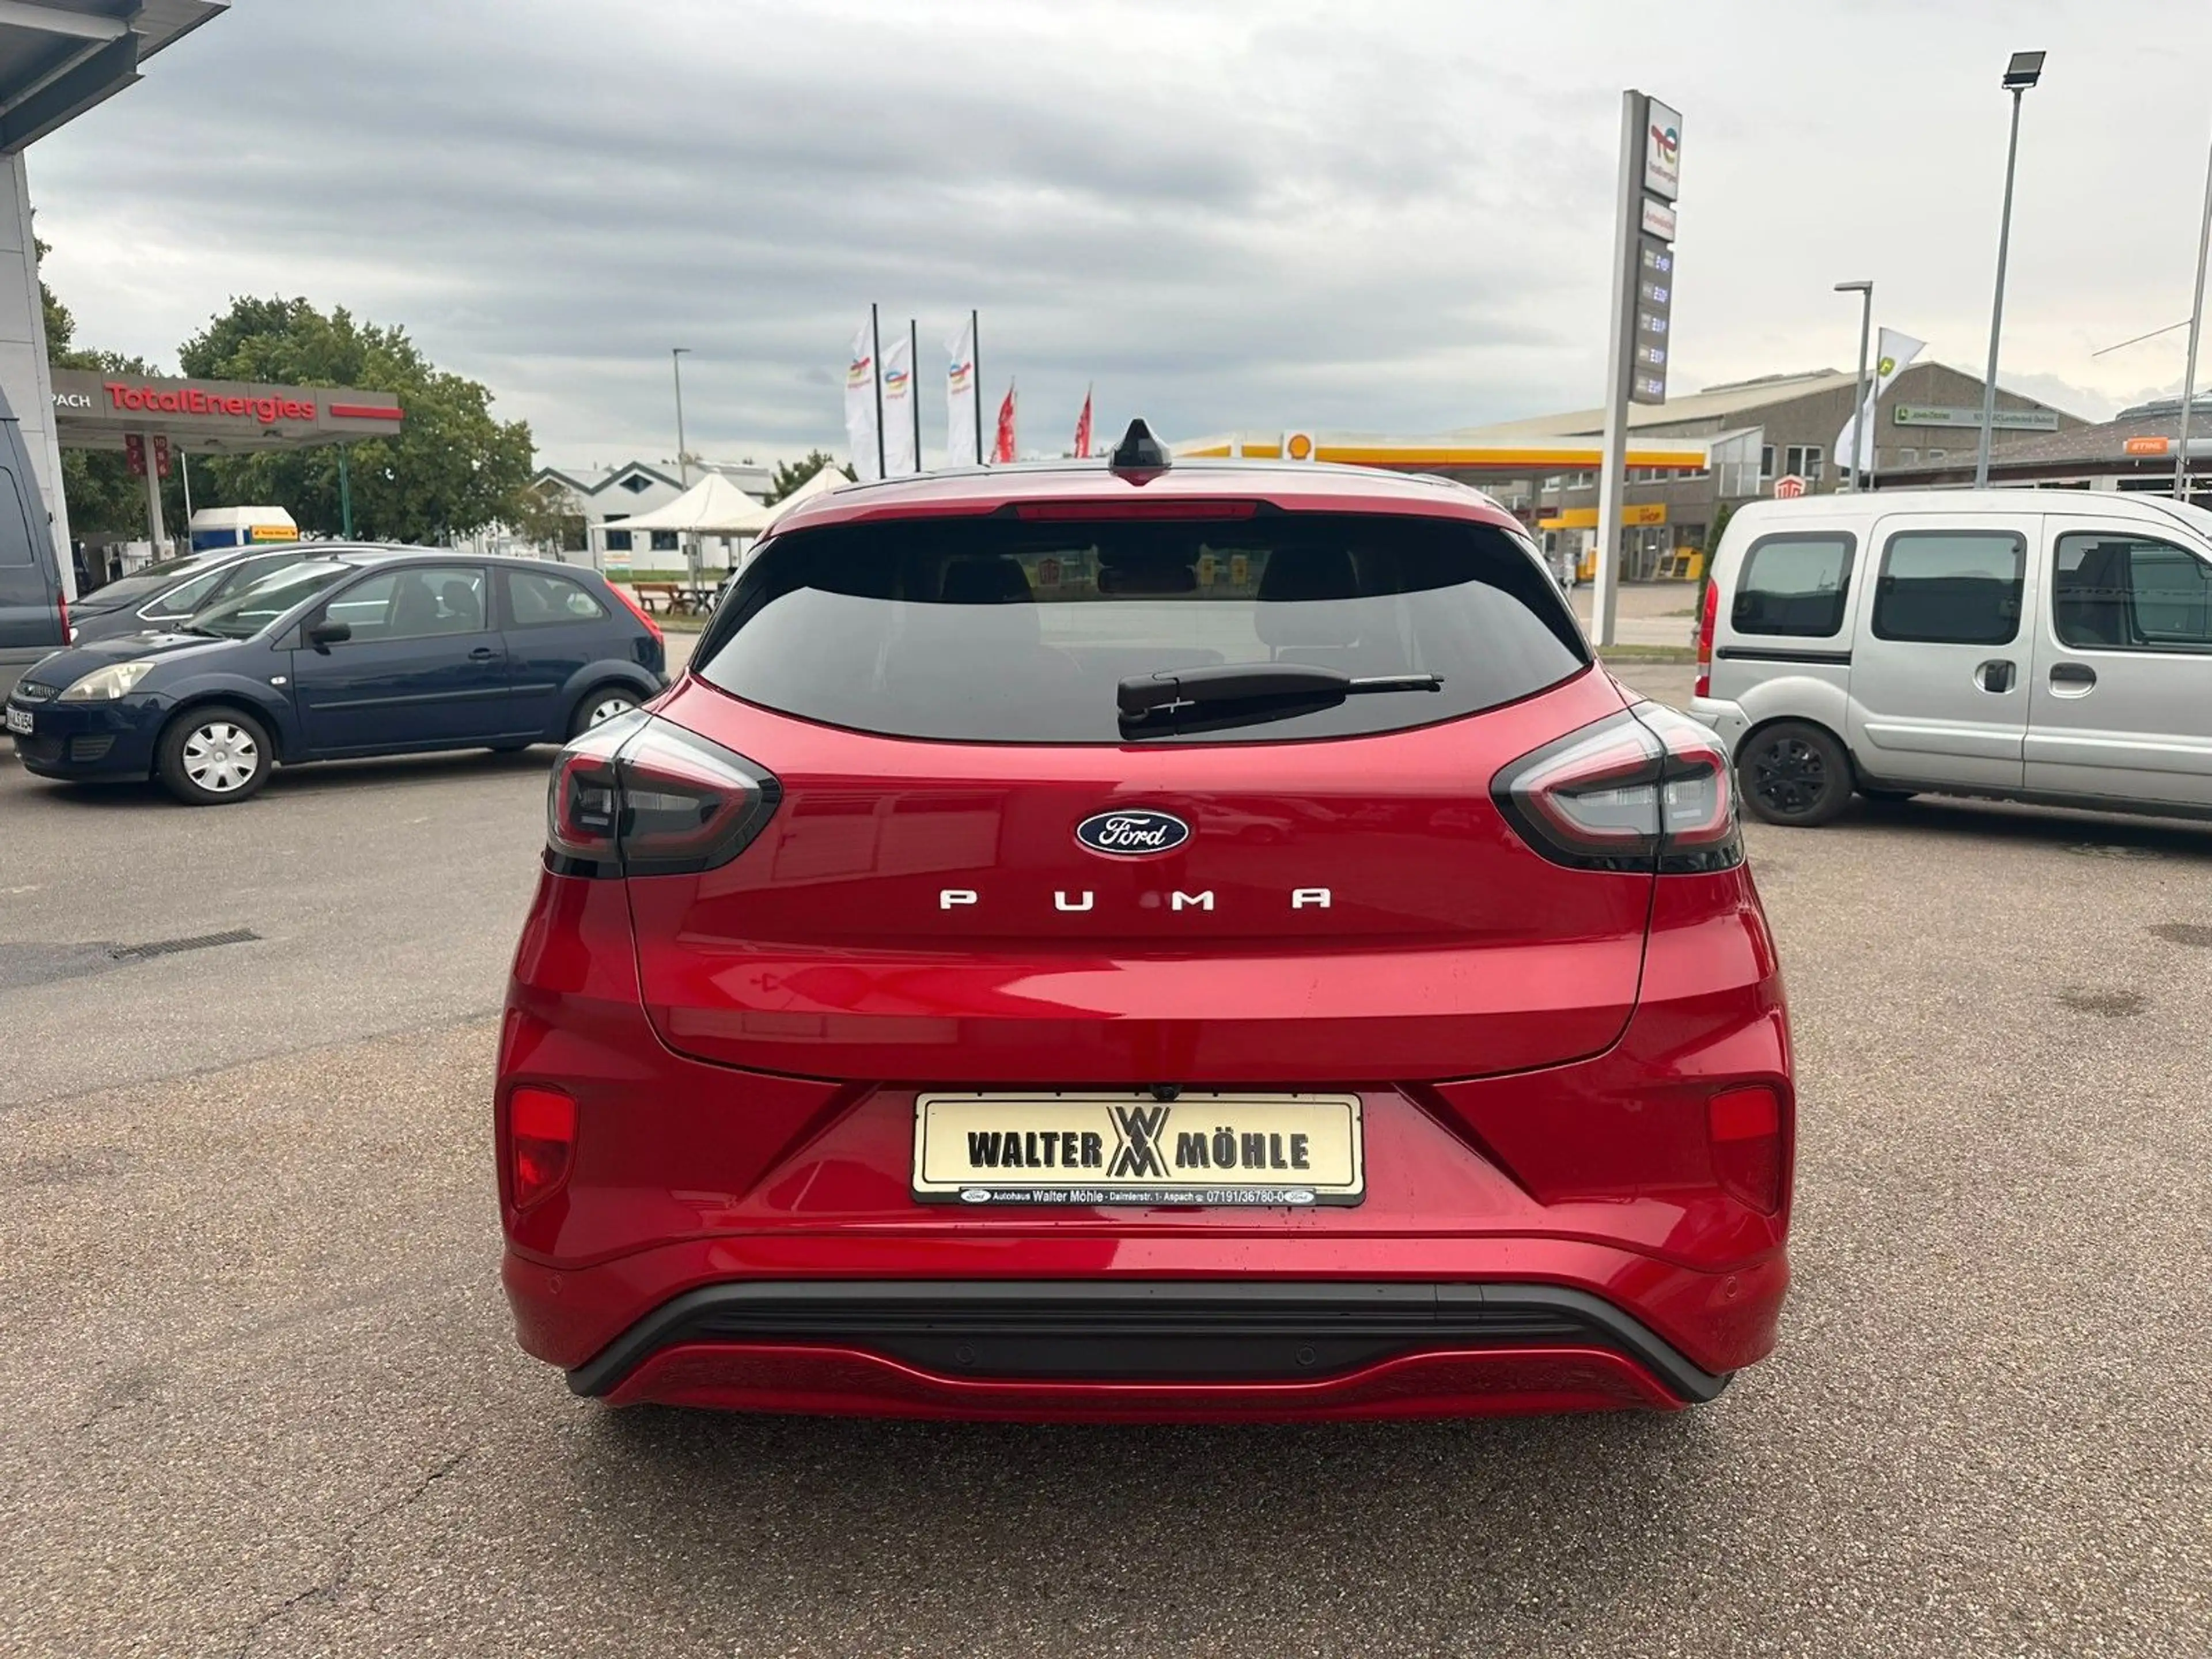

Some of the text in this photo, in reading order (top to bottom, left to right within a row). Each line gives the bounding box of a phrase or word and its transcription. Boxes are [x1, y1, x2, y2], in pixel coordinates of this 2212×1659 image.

[105, 382, 316, 422] TotalEnergies
[1099, 817, 1166, 846] Ford
[940, 889, 1331, 911] PUMA
[967, 1127, 1310, 1169] WALTER MÖHLE
[993, 1192, 1031, 1200] Autohaus
[1033, 1190, 1067, 1202] Walter
[1070, 1189, 1103, 1202] Möhle
[1164, 1192, 1194, 1203] Aspach
[1207, 1191, 1284, 1203] 07191/36780-0
